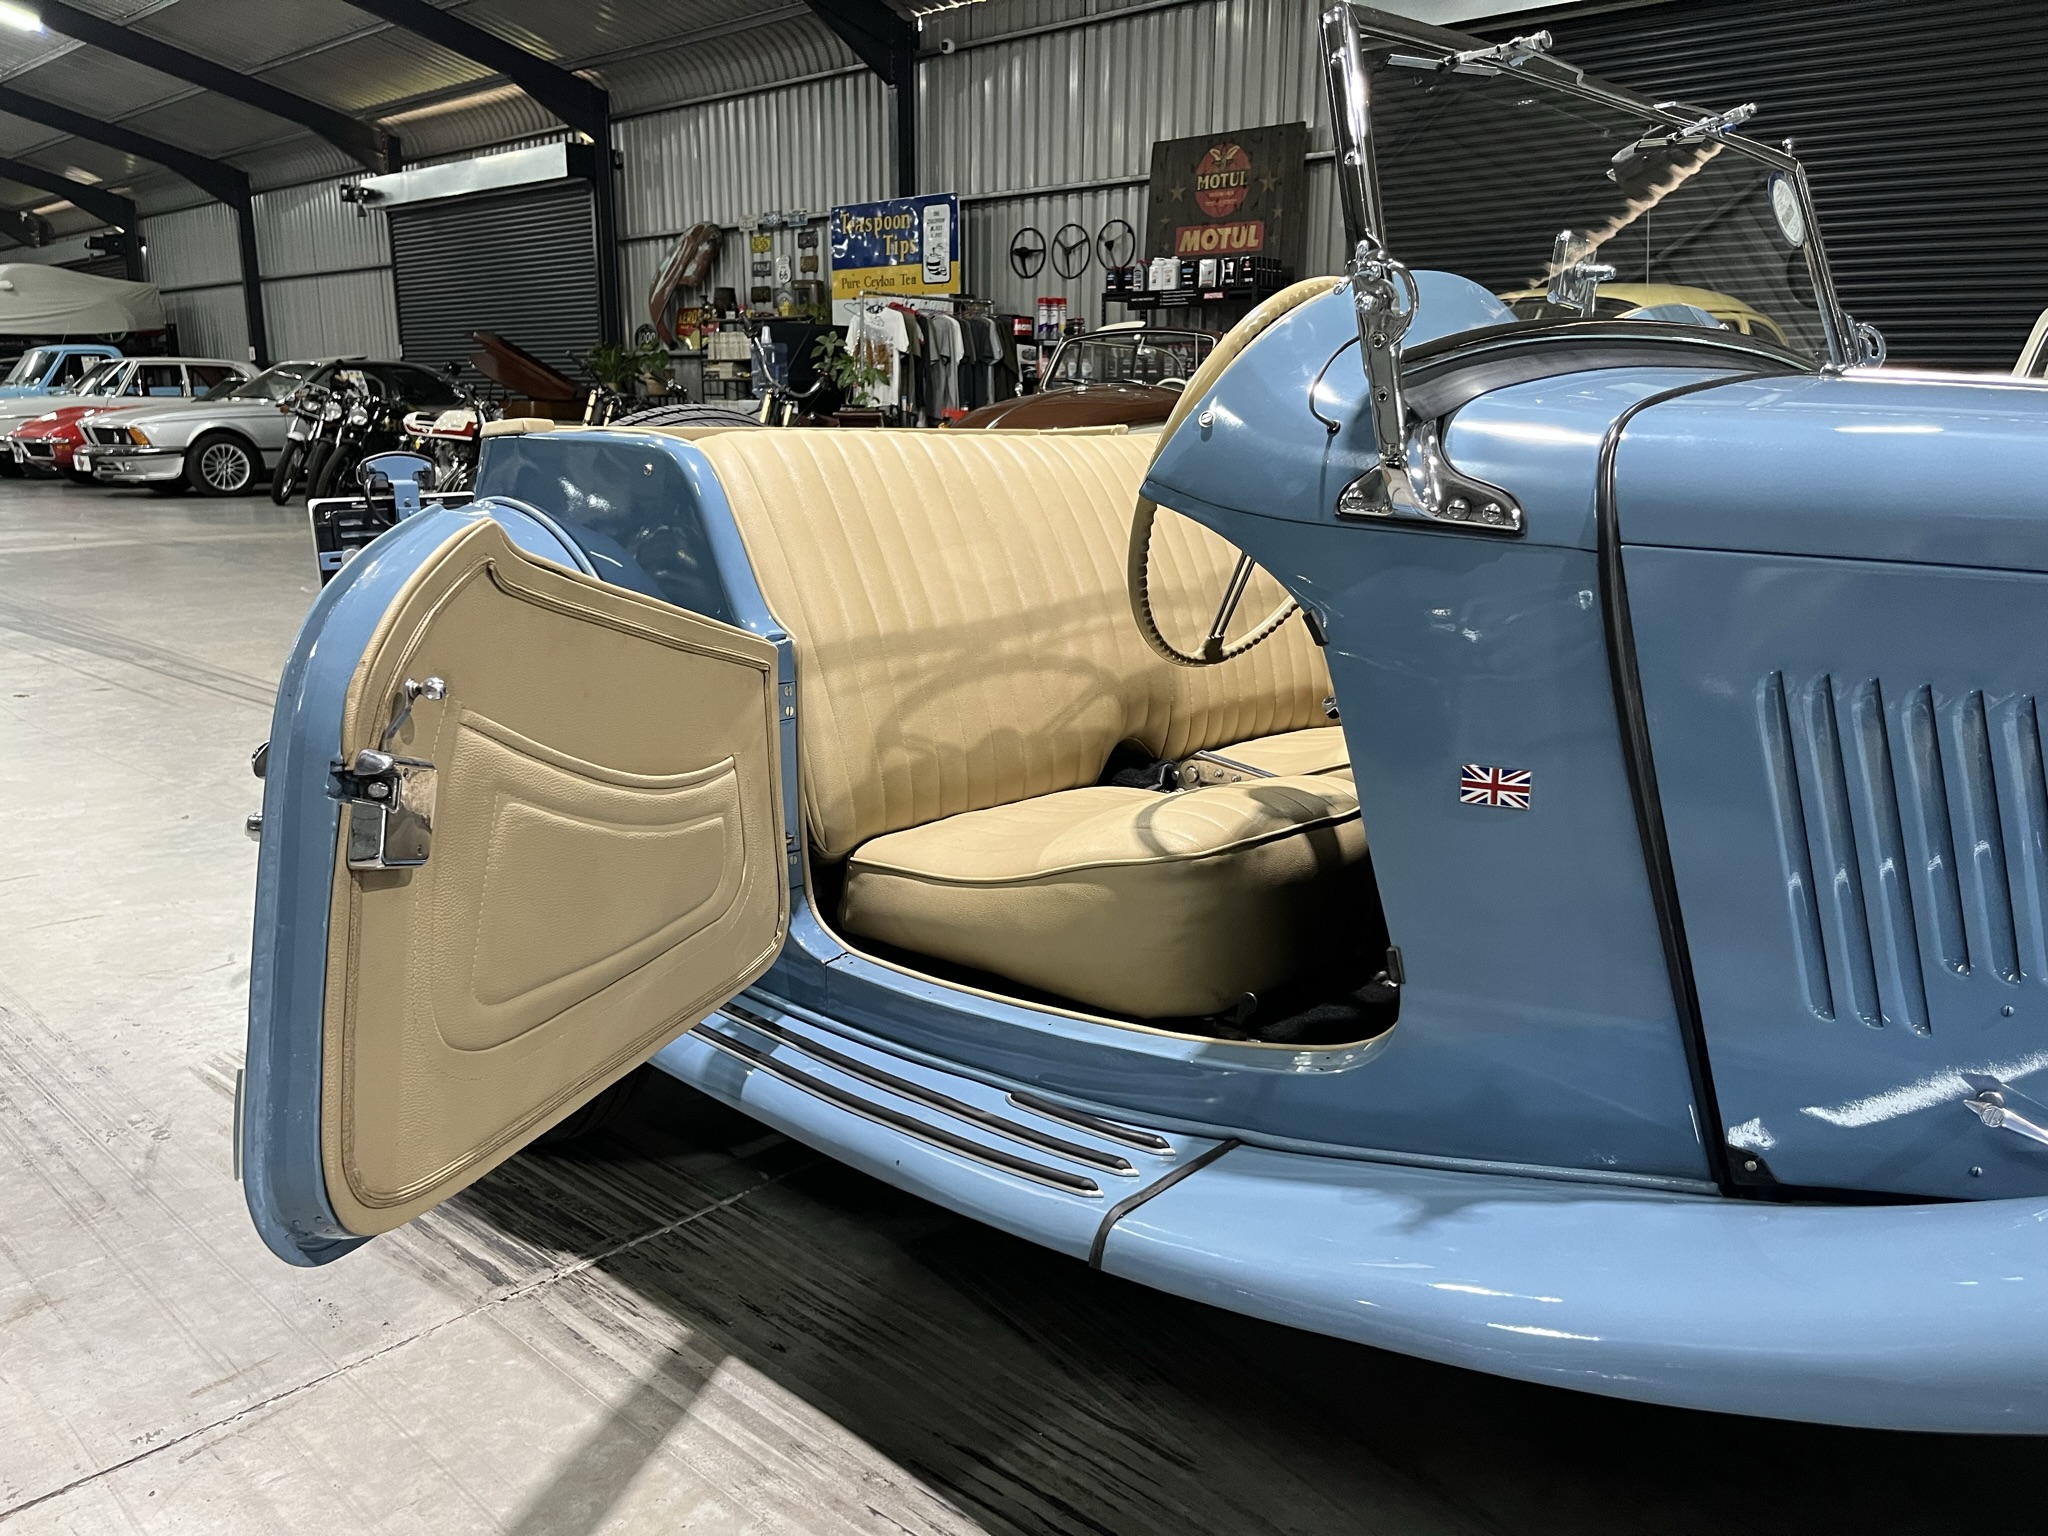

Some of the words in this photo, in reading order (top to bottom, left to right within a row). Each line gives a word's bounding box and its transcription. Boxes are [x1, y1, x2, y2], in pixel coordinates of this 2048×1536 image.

[1197, 171, 1248, 191] MOTUL
[841, 212, 911, 239] Teaspoon
[1178, 224, 1259, 253] MOTUL
[883, 234, 918, 262] Tips
[841, 278, 861, 289] Pure
[864, 275, 895, 290] Ceylon
[900, 274, 917, 286] Tea
